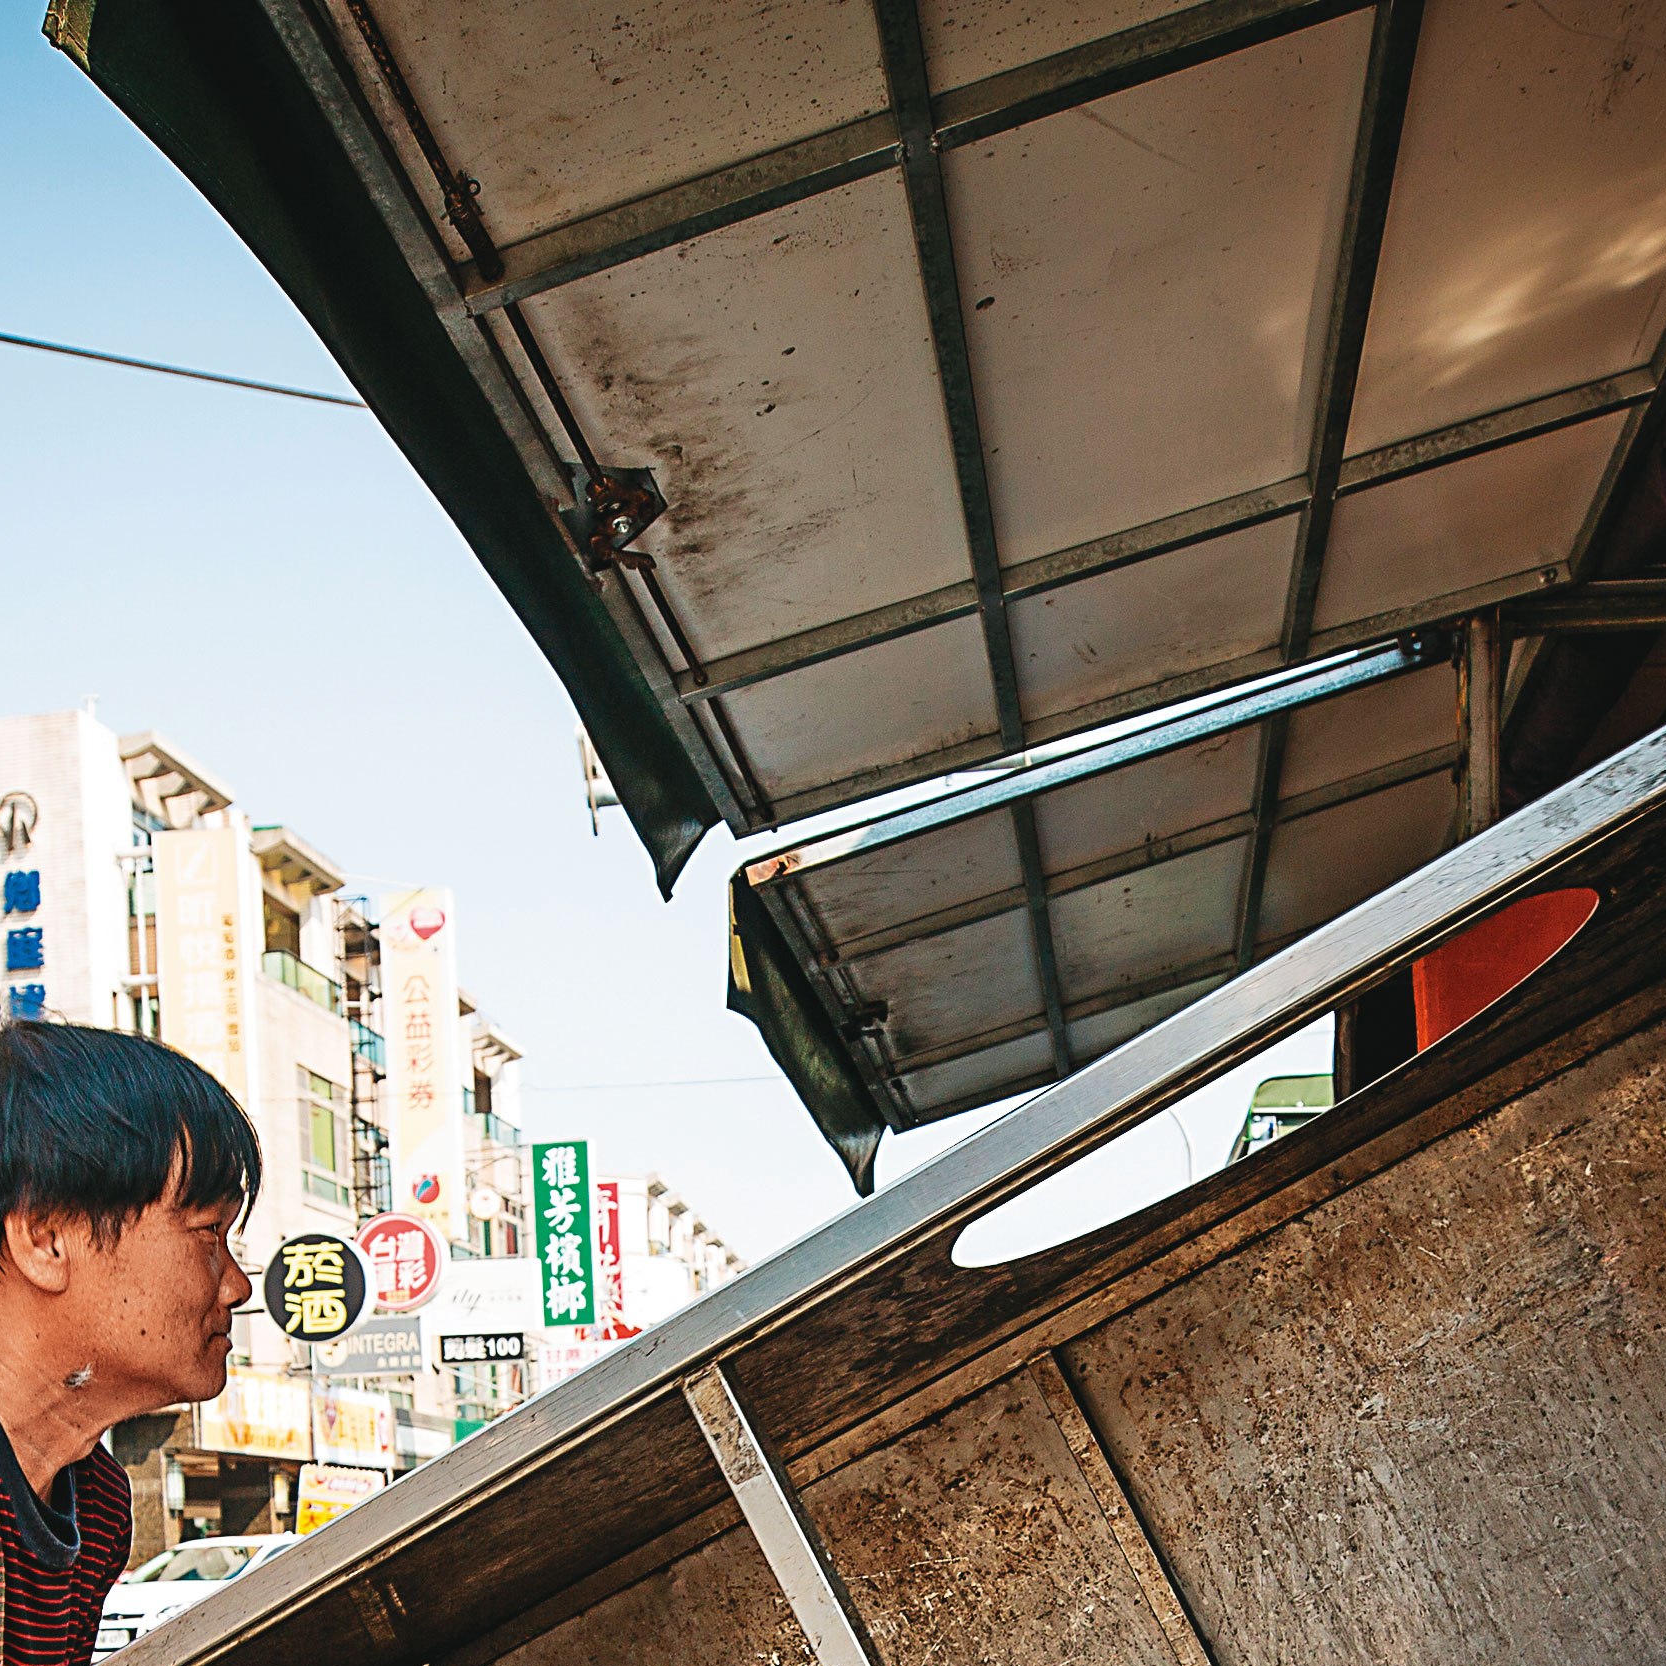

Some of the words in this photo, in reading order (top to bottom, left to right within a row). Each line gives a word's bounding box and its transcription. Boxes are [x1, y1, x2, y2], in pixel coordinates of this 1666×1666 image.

[403, 974, 433, 1111] 公益彩券
[369, 1229, 425, 1262] 台灣
[541, 1146, 586, 1320] 雅芳檳榔
[282, 1241, 347, 1334] 菸酒
[348, 1331, 420, 1355] INTEGRA
